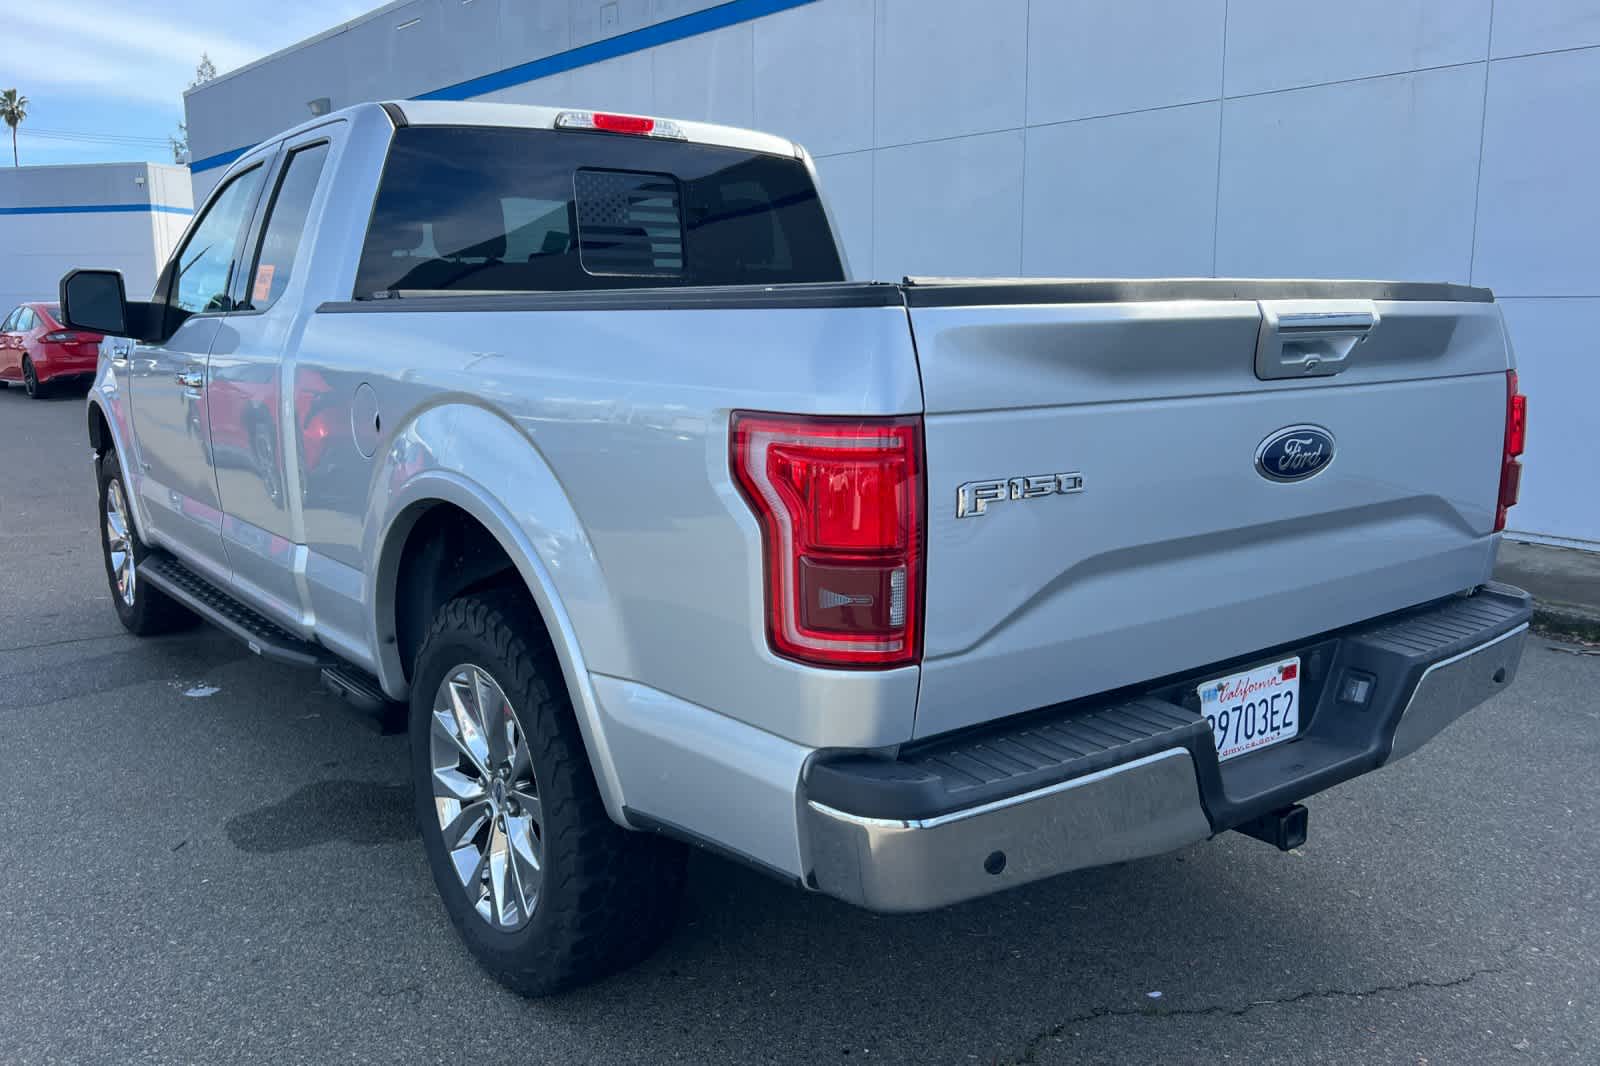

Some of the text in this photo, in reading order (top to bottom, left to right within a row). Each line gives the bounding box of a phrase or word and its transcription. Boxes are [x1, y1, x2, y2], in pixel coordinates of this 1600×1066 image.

[1279, 438, 1323, 470] Ford
[956, 472, 1083, 518] F150
[1219, 677, 1282, 703] California
